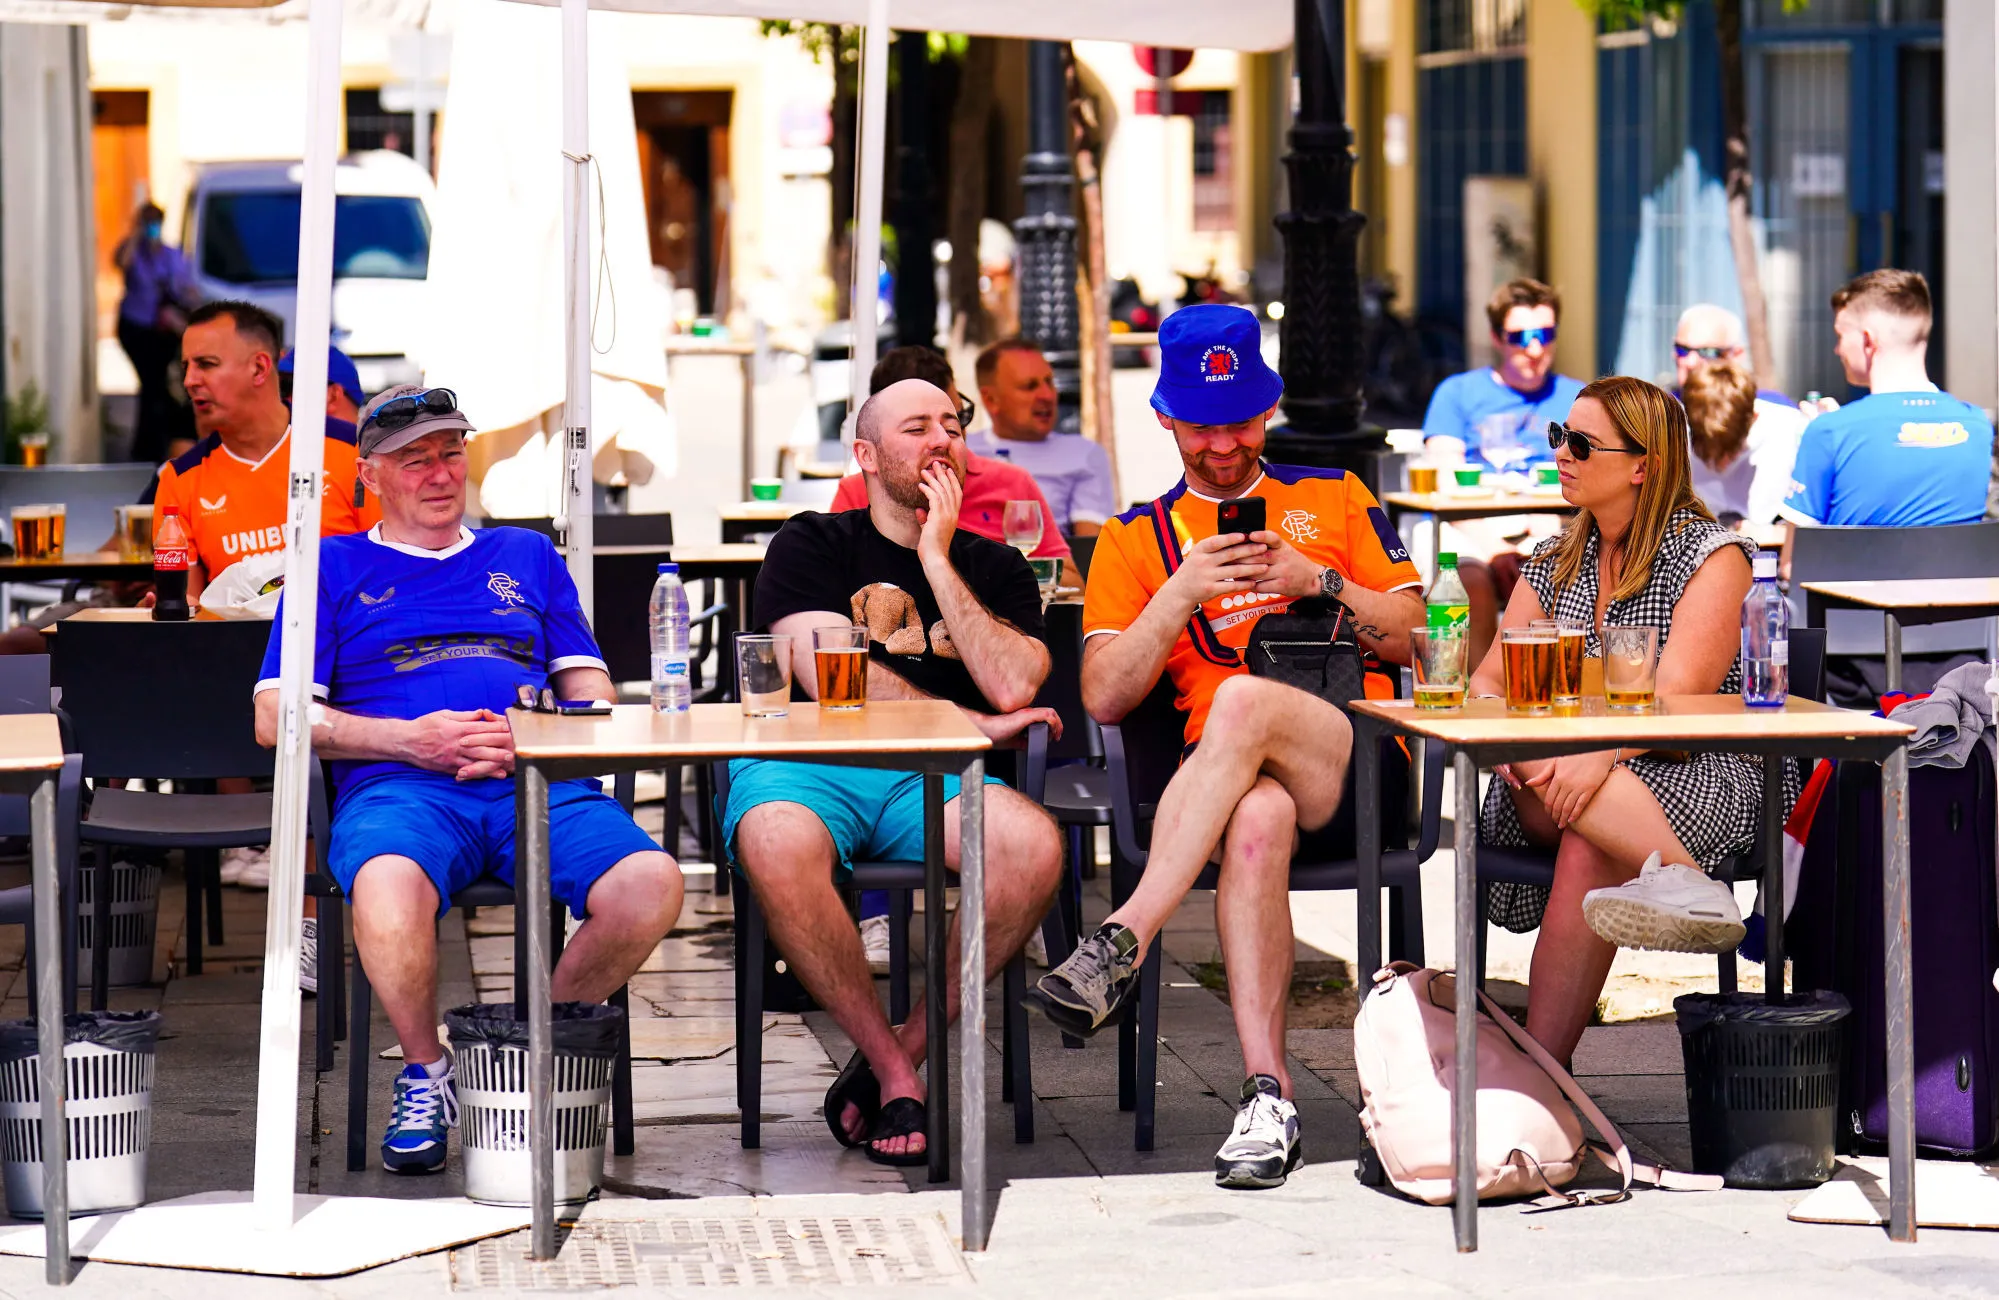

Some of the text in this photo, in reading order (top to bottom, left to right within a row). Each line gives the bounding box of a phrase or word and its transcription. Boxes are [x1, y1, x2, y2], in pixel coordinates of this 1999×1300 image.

[1200, 344, 1240, 373] WE ARE THE PEOPLE
[1205, 374, 1236, 383] READY
[221, 522, 287, 555] UNIB
[1225, 615, 1241, 625] SET
[1242, 608, 1267, 620] YOUR
[420, 651, 444, 665] SET
[445, 647, 480, 657] YOUR
